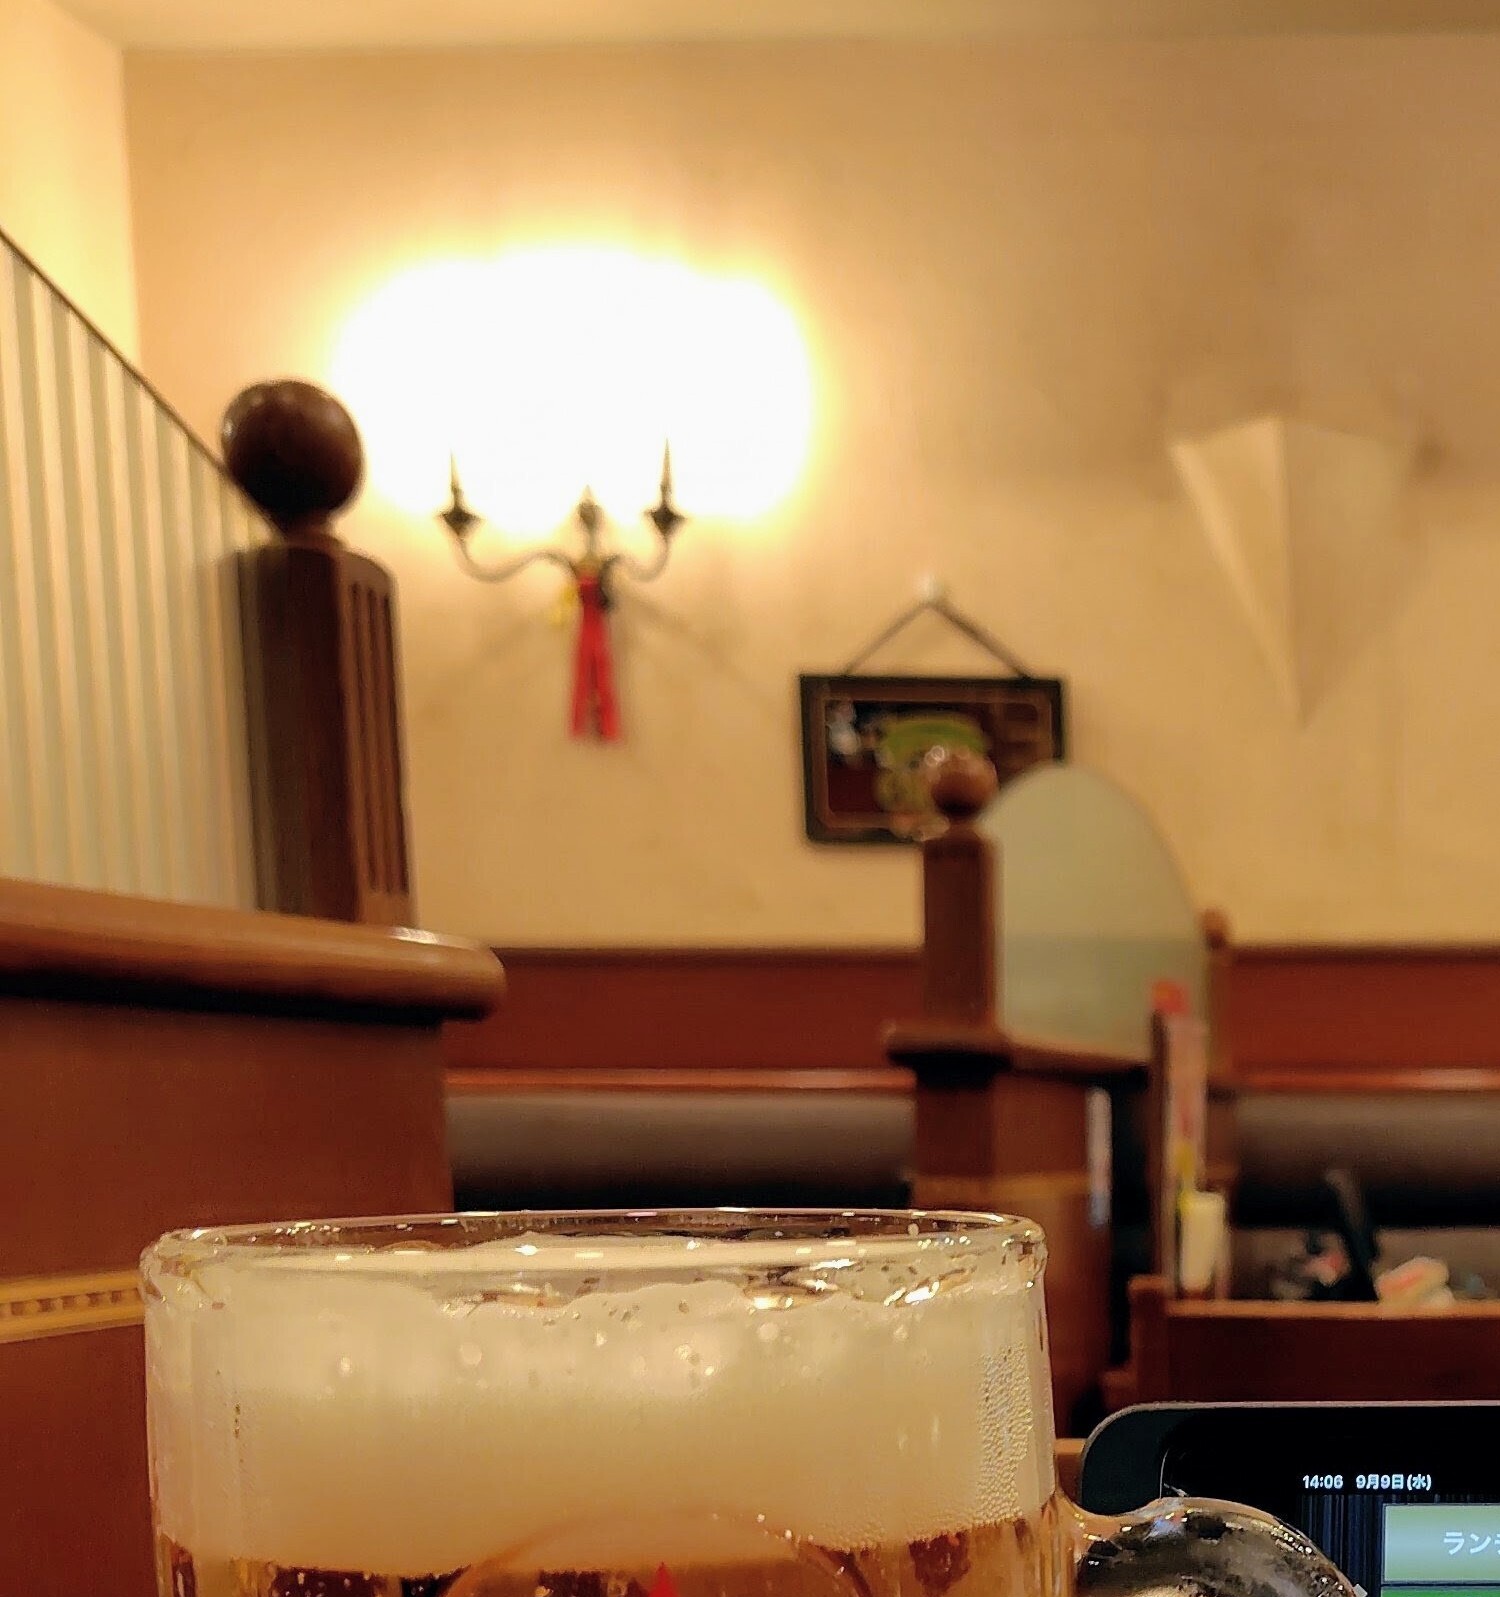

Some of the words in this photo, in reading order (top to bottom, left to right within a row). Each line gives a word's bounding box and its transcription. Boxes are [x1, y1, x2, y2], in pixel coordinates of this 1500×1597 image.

[1302, 1474, 1344, 1490] 14:06
[1355, 1473, 1432, 1491] 9月9日(水)
